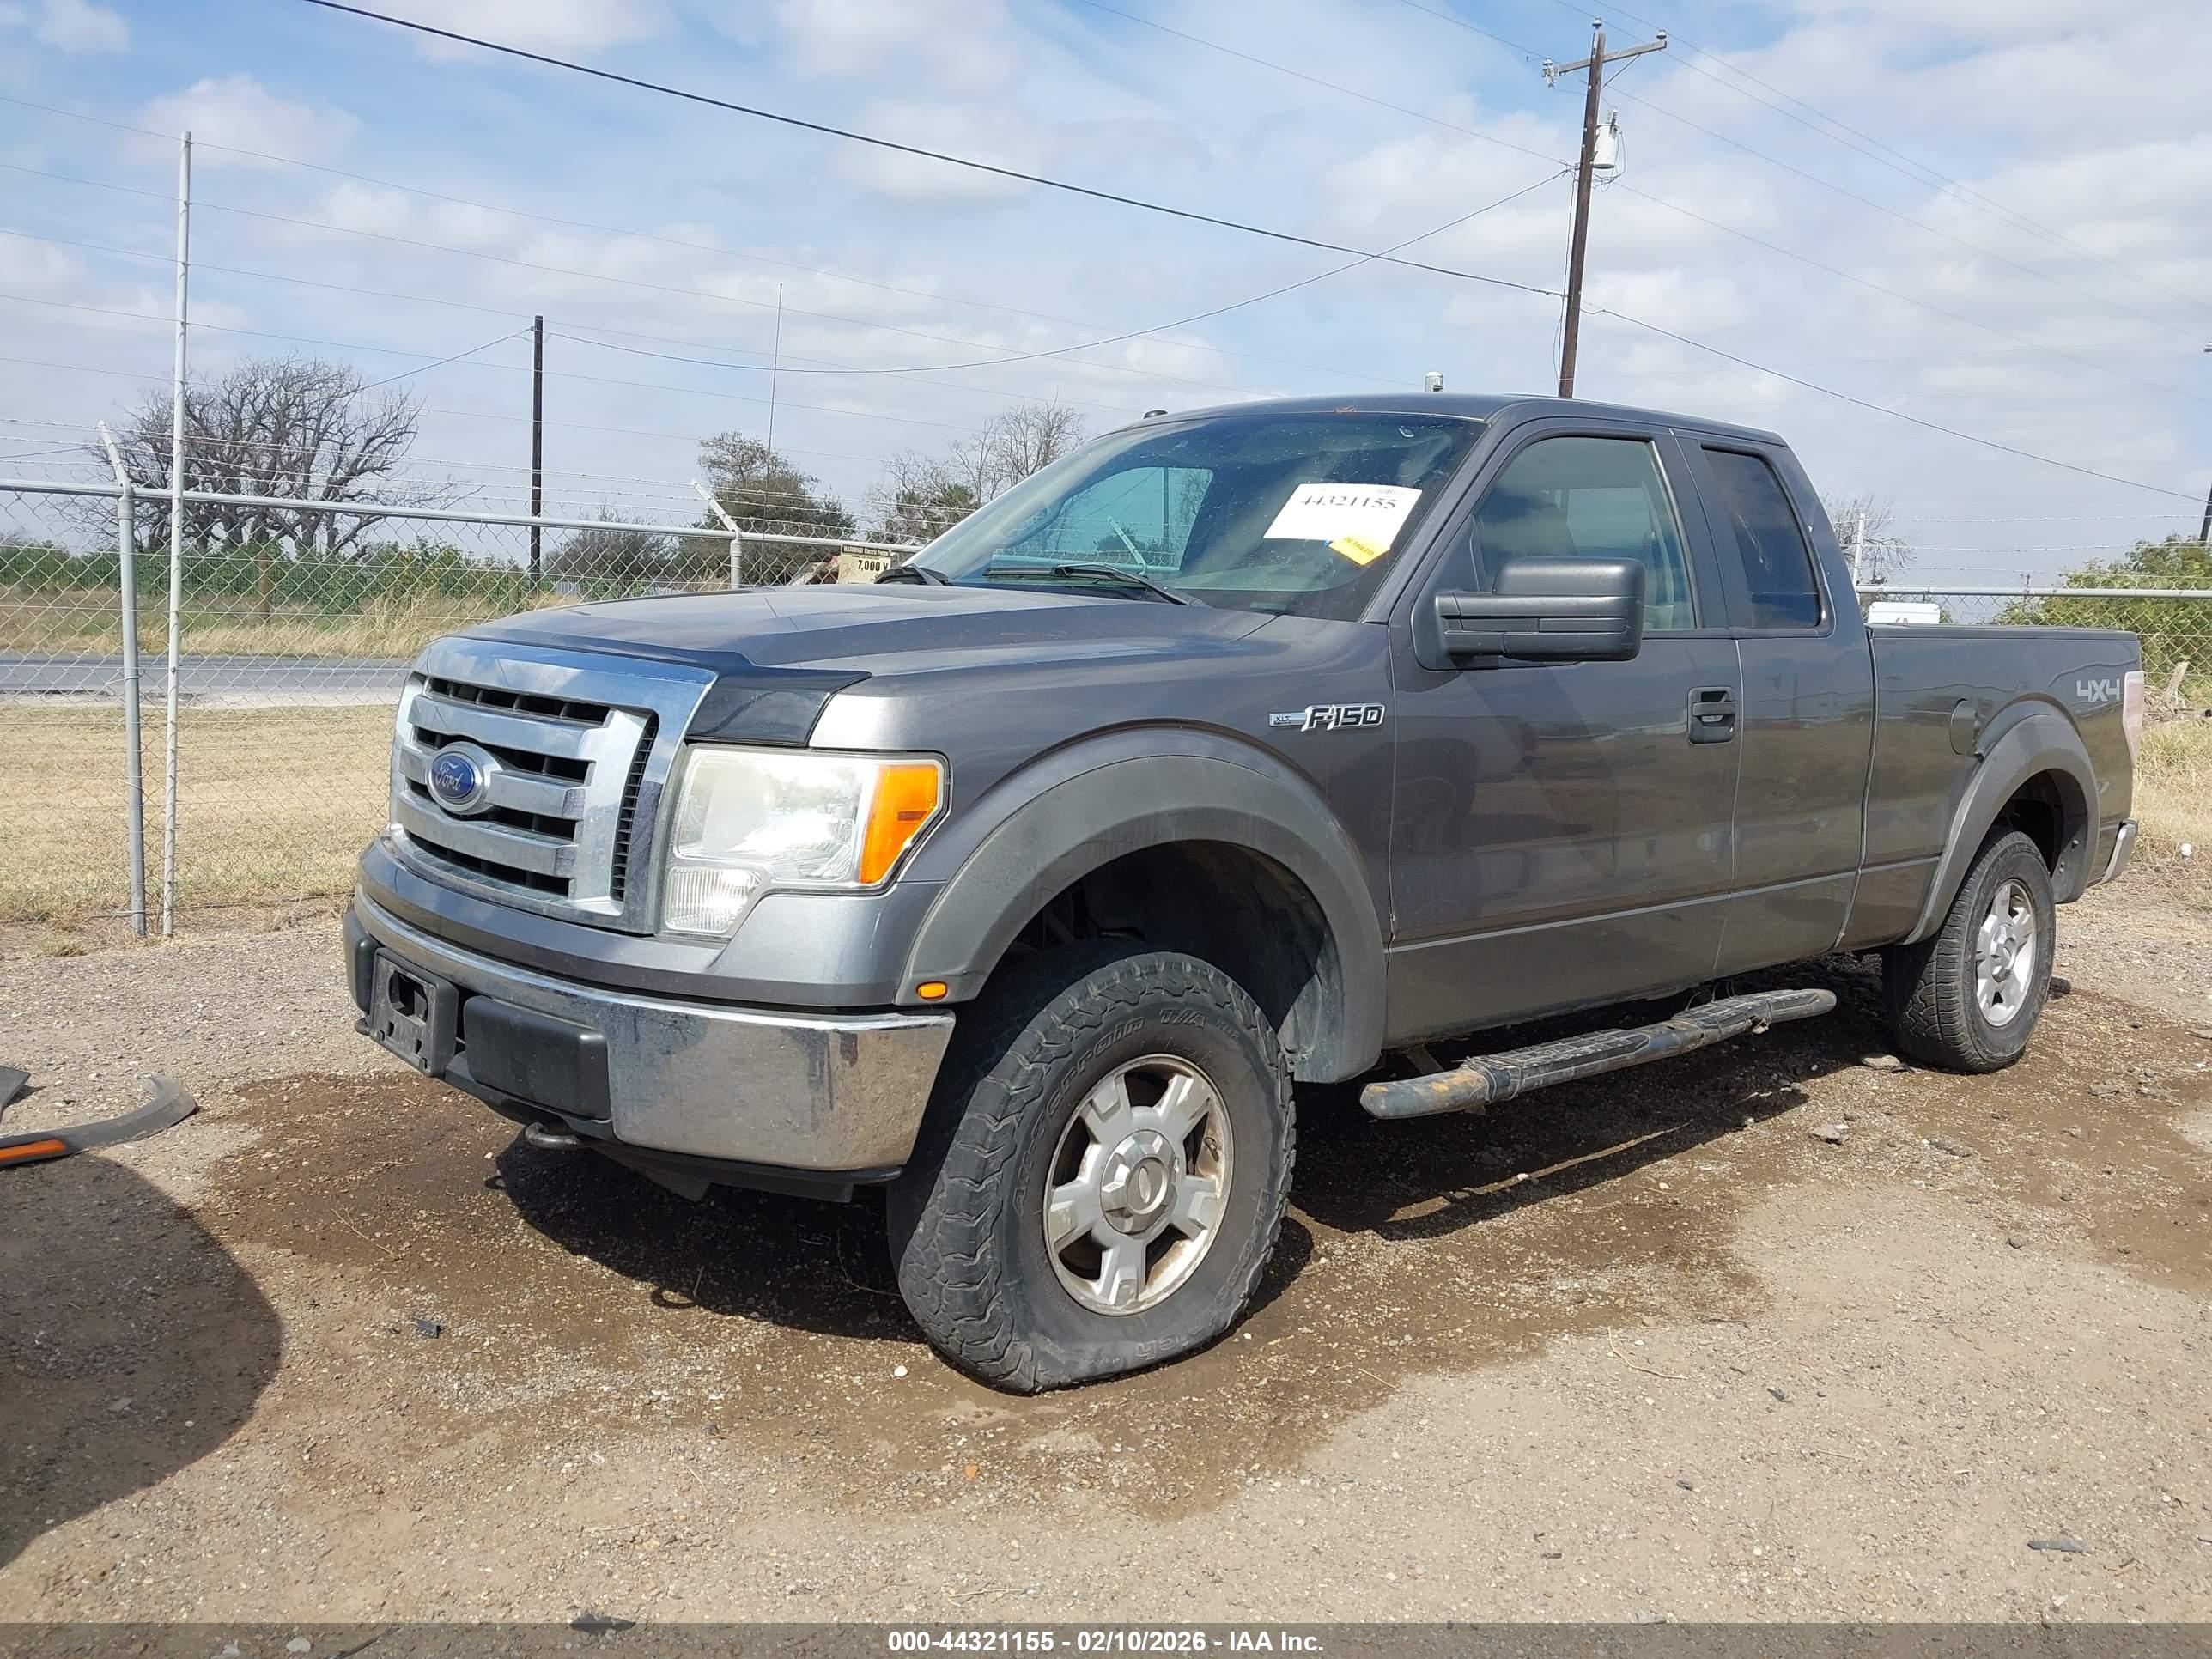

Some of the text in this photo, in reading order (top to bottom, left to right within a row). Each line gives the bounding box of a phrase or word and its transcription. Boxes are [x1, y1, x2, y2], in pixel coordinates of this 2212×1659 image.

[1300, 495, 1398, 509] 44321155
[1343, 536, 1375, 556] DETAILED
[858, 559, 881, 572] 7,000
[435, 760, 465, 791] Ford
